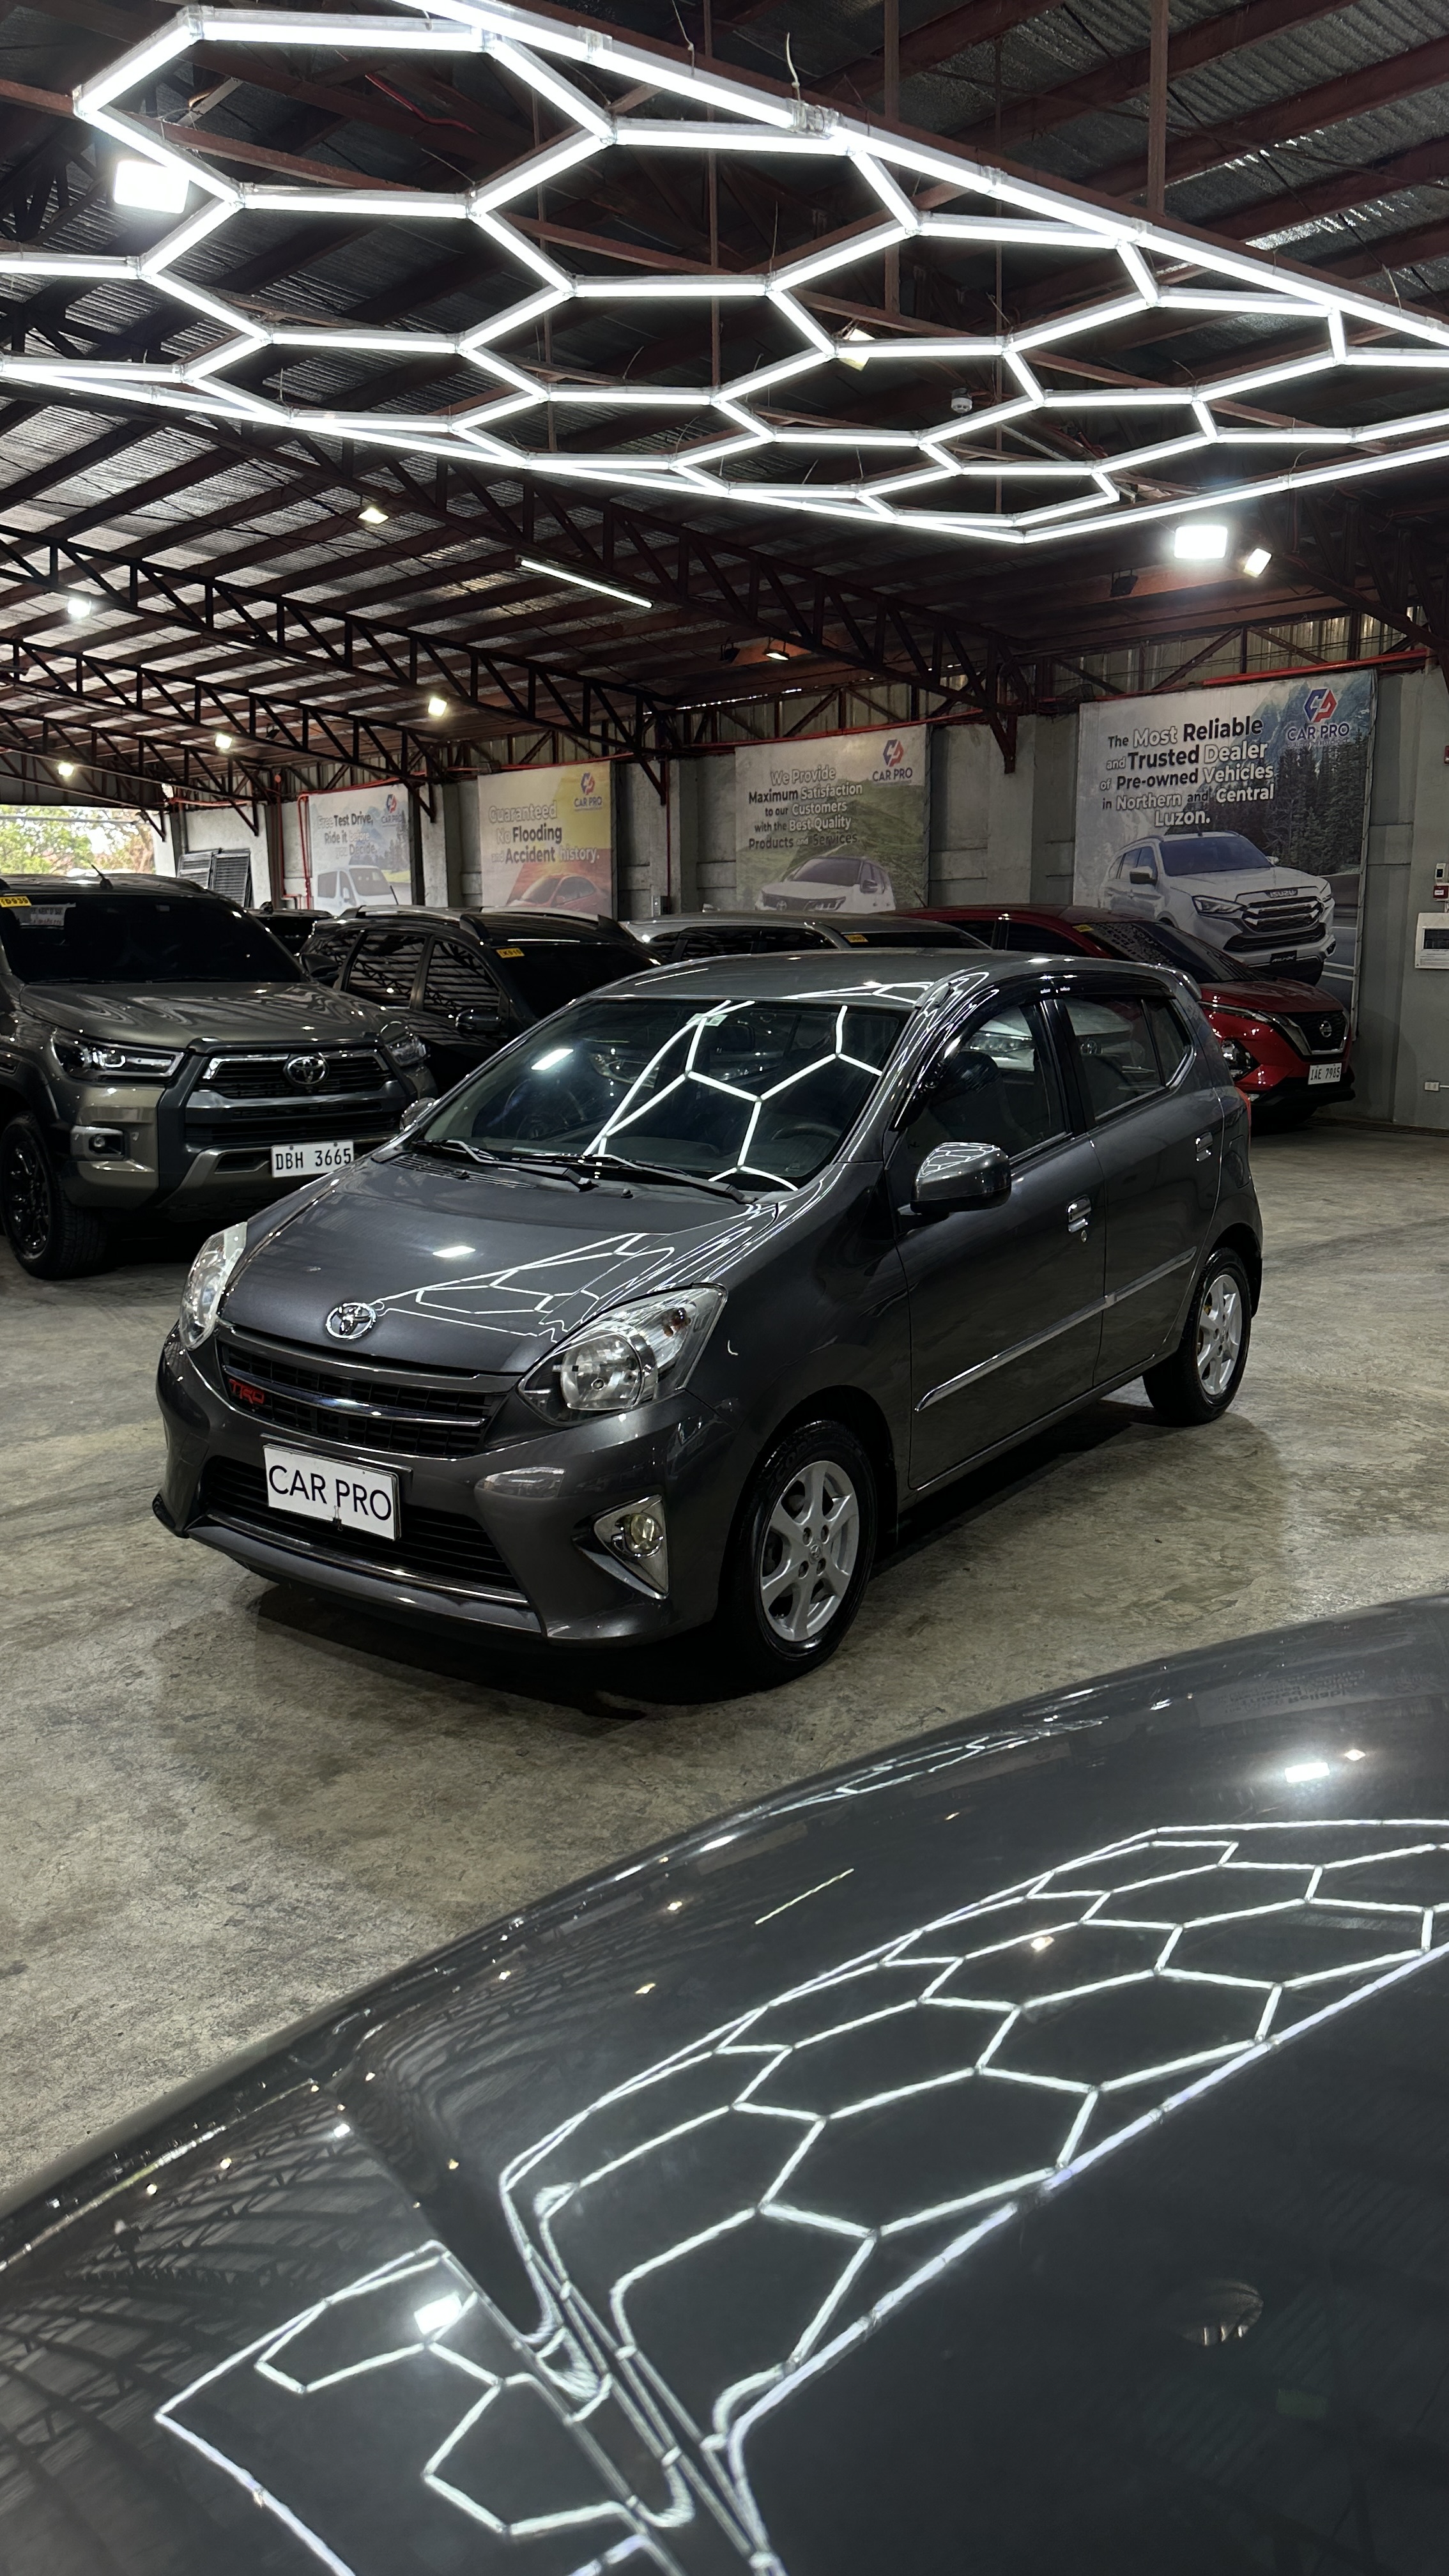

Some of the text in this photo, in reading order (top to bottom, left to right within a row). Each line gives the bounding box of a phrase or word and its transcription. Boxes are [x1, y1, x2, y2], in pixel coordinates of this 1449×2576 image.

[1108, 716, 1264, 748] The Most Reliable
[1287, 723, 1350, 742] CAR PRO
[1107, 756, 1126, 770] and
[1128, 744, 1200, 769] Trusted
[1204, 741, 1268, 763] Dealer
[770, 765, 836, 786] We Provide
[872, 767, 913, 782] CAR PRO
[1100, 764, 1274, 791] of Pre-owned Vehicles
[574, 796, 602, 808] CAR PRO
[749, 788, 798, 804] Maximum
[801, 781, 862, 800] Satisfaction
[1102, 783, 1275, 811] in Northern and Central
[489, 800, 557, 824] Guaranteed
[765, 801, 847, 816] to our Customers
[1154, 810, 1211, 827] Luzon.
[334, 814, 349, 827] Test
[351, 811, 373, 825] Drive,
[755, 815, 851, 832] with the Best Quality
[325, 831, 340, 845] Ride
[342, 830, 348, 843] it
[512, 824, 562, 844] Flooding
[749, 837, 793, 849] Products
[505, 846, 556, 864] Accident
[560, 845, 601, 863] history.
[275, 1148, 351, 1170] DBH 3665
[229, 1378, 264, 1404] TRD
[269, 1464, 392, 1521] CAR PRO
